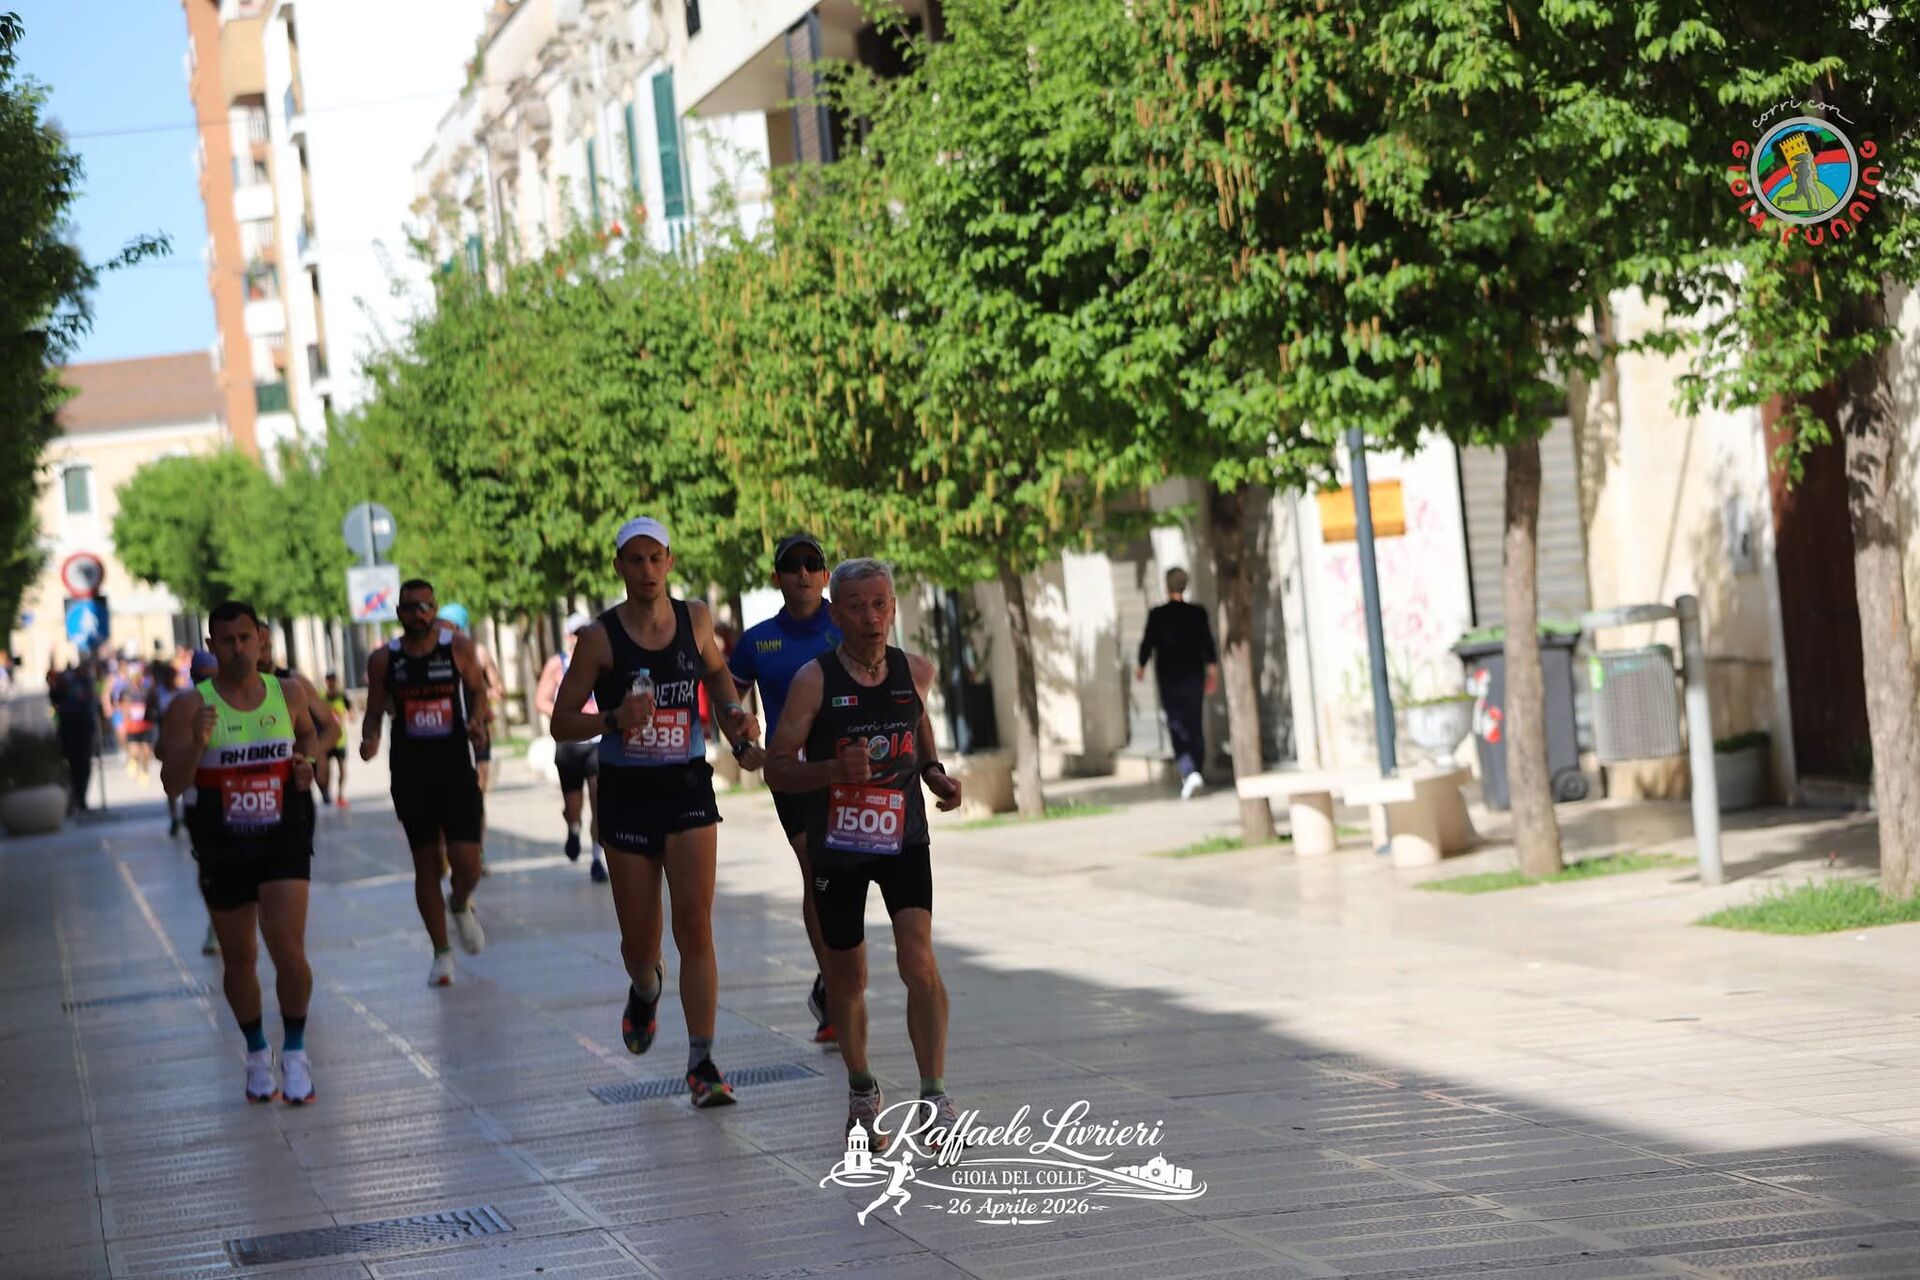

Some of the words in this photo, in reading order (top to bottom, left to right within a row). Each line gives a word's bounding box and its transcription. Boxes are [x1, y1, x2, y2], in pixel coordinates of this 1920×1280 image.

[415, 711, 442, 728] 661
[628, 726, 684, 748] 2938
[230, 791, 276, 812] 2015
[836, 806, 897, 835] 1500
